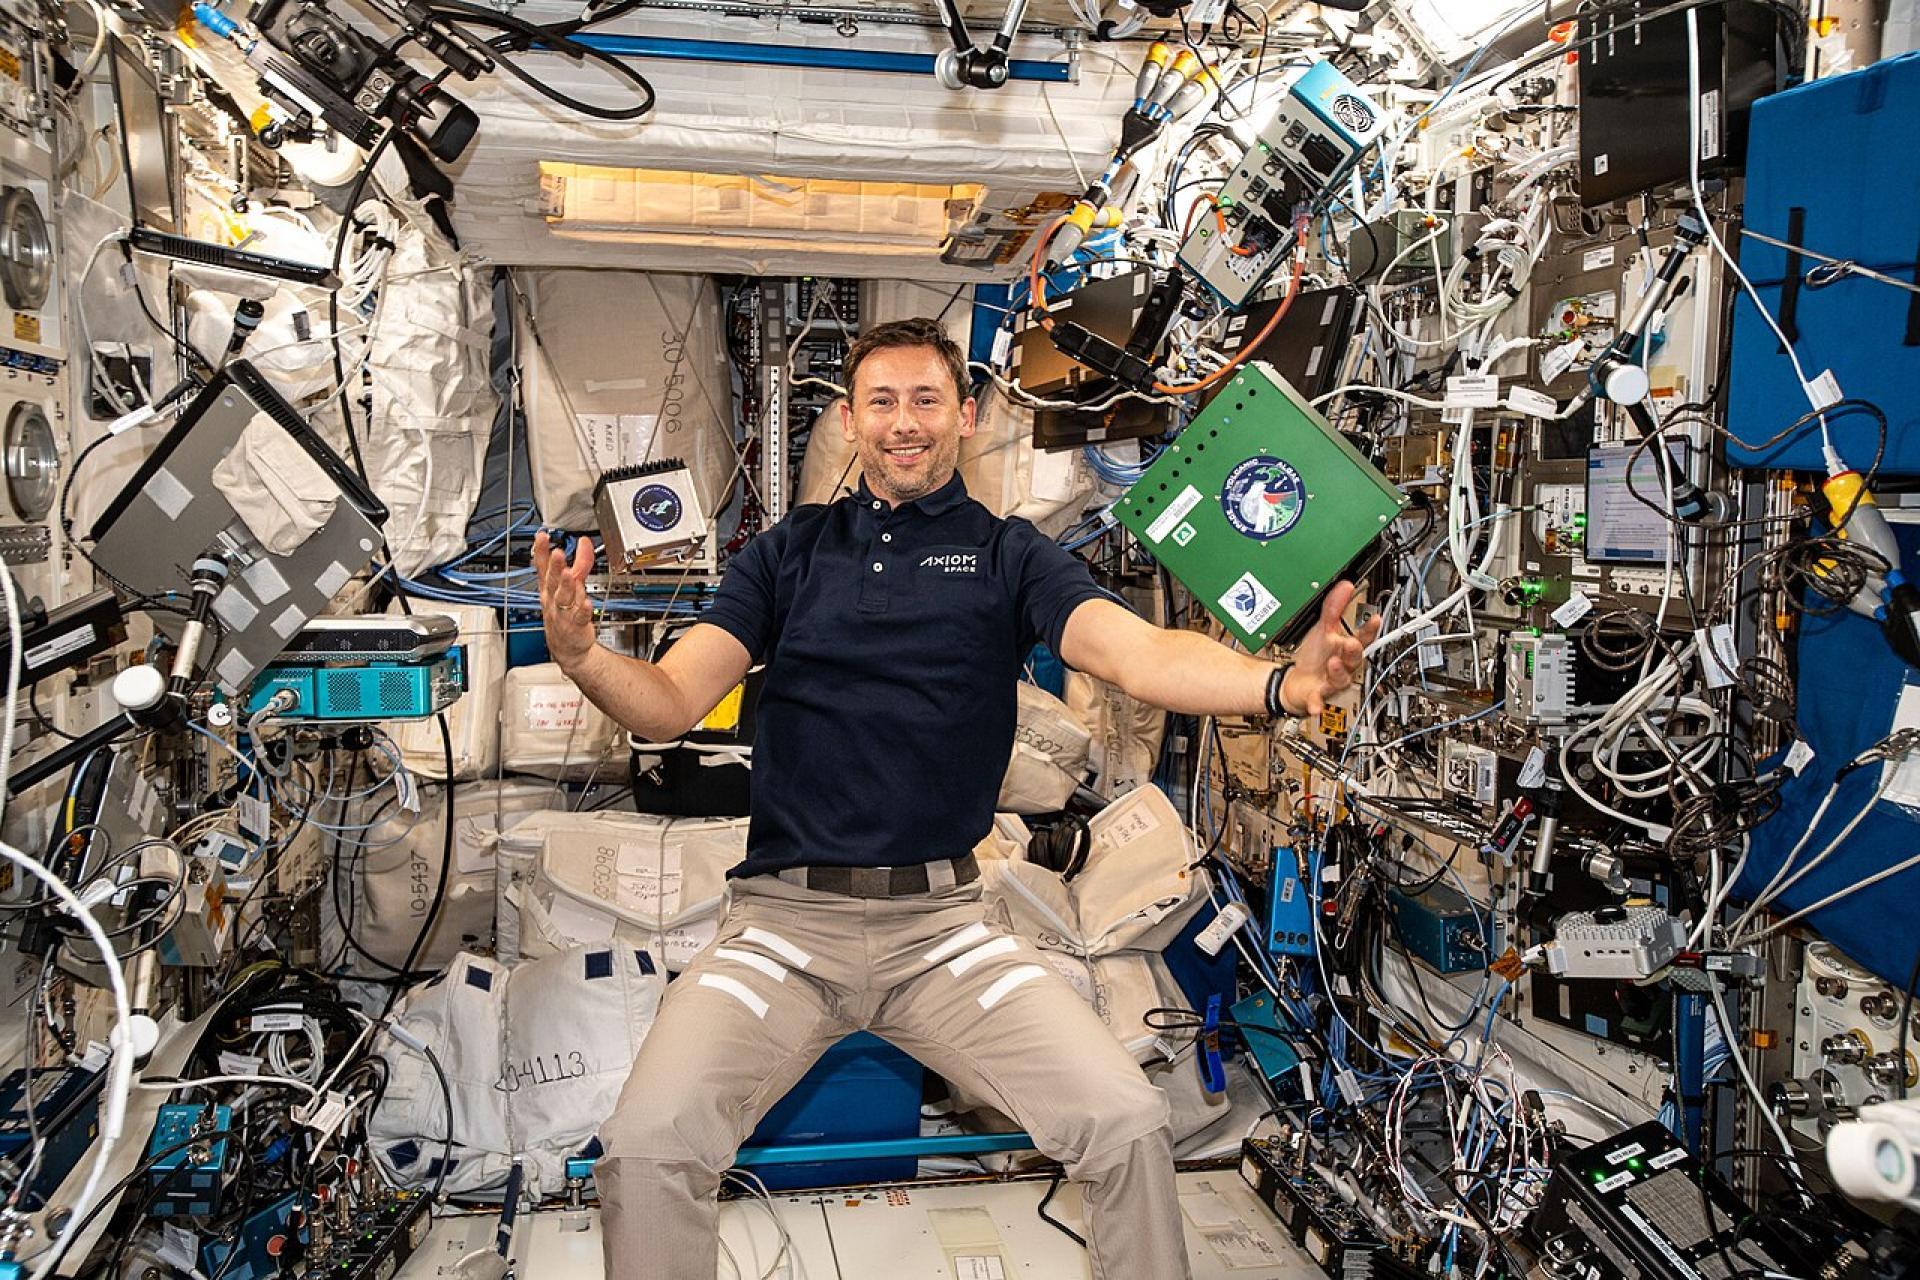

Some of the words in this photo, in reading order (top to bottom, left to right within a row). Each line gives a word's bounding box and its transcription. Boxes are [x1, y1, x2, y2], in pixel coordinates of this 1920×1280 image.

[1225, 458, 1259, 490] VOLCANIC
[1277, 461, 1300, 483] ALGAE
[1226, 510, 1248, 534] SPACE
[919, 555, 977, 567] AXIOM
